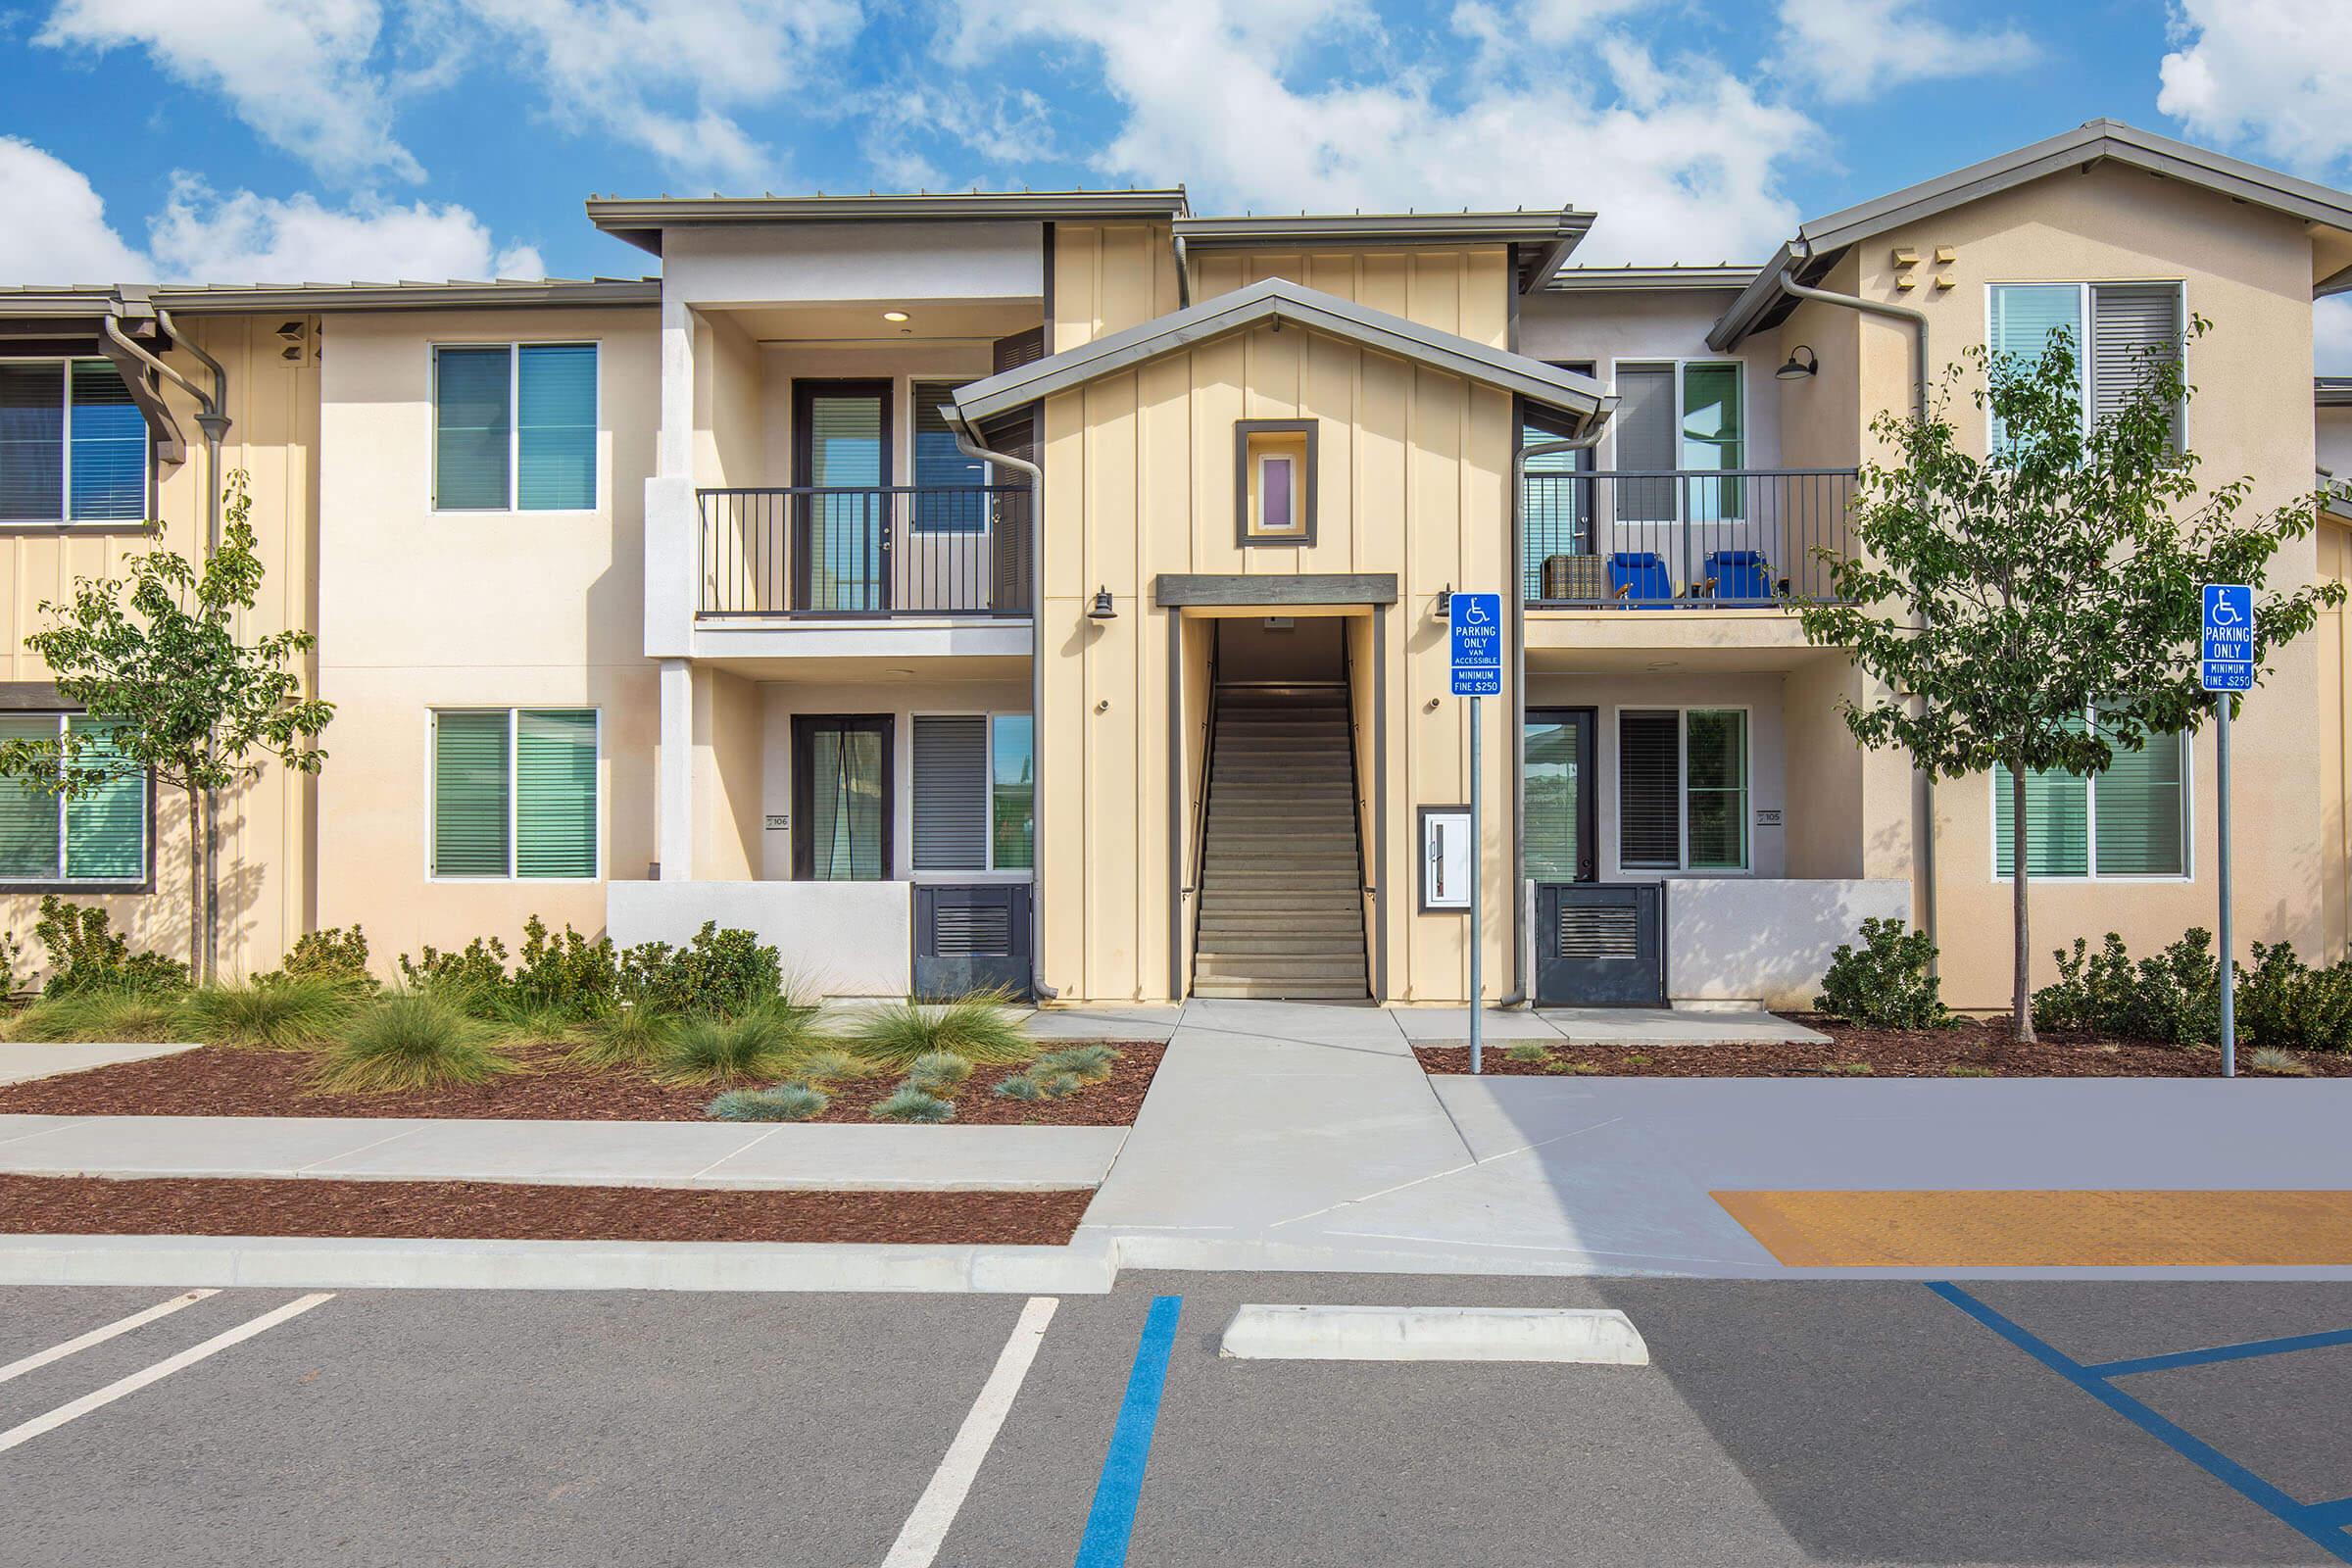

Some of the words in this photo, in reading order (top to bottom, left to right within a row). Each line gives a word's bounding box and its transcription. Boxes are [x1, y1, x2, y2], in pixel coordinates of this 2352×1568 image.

[1456, 626, 1495, 636] PARKING
[2206, 627, 2249, 642] PARKING
[1464, 638, 1488, 648] ONLY
[2215, 644, 2241, 659] ONLY
[2211, 663, 2244, 674] MINIMUM
[1455, 682, 1472, 691] FINE
[1475, 682, 1497, 691] $250
[2205, 675, 2223, 686] FINE
[2227, 675, 2250, 687] $250
